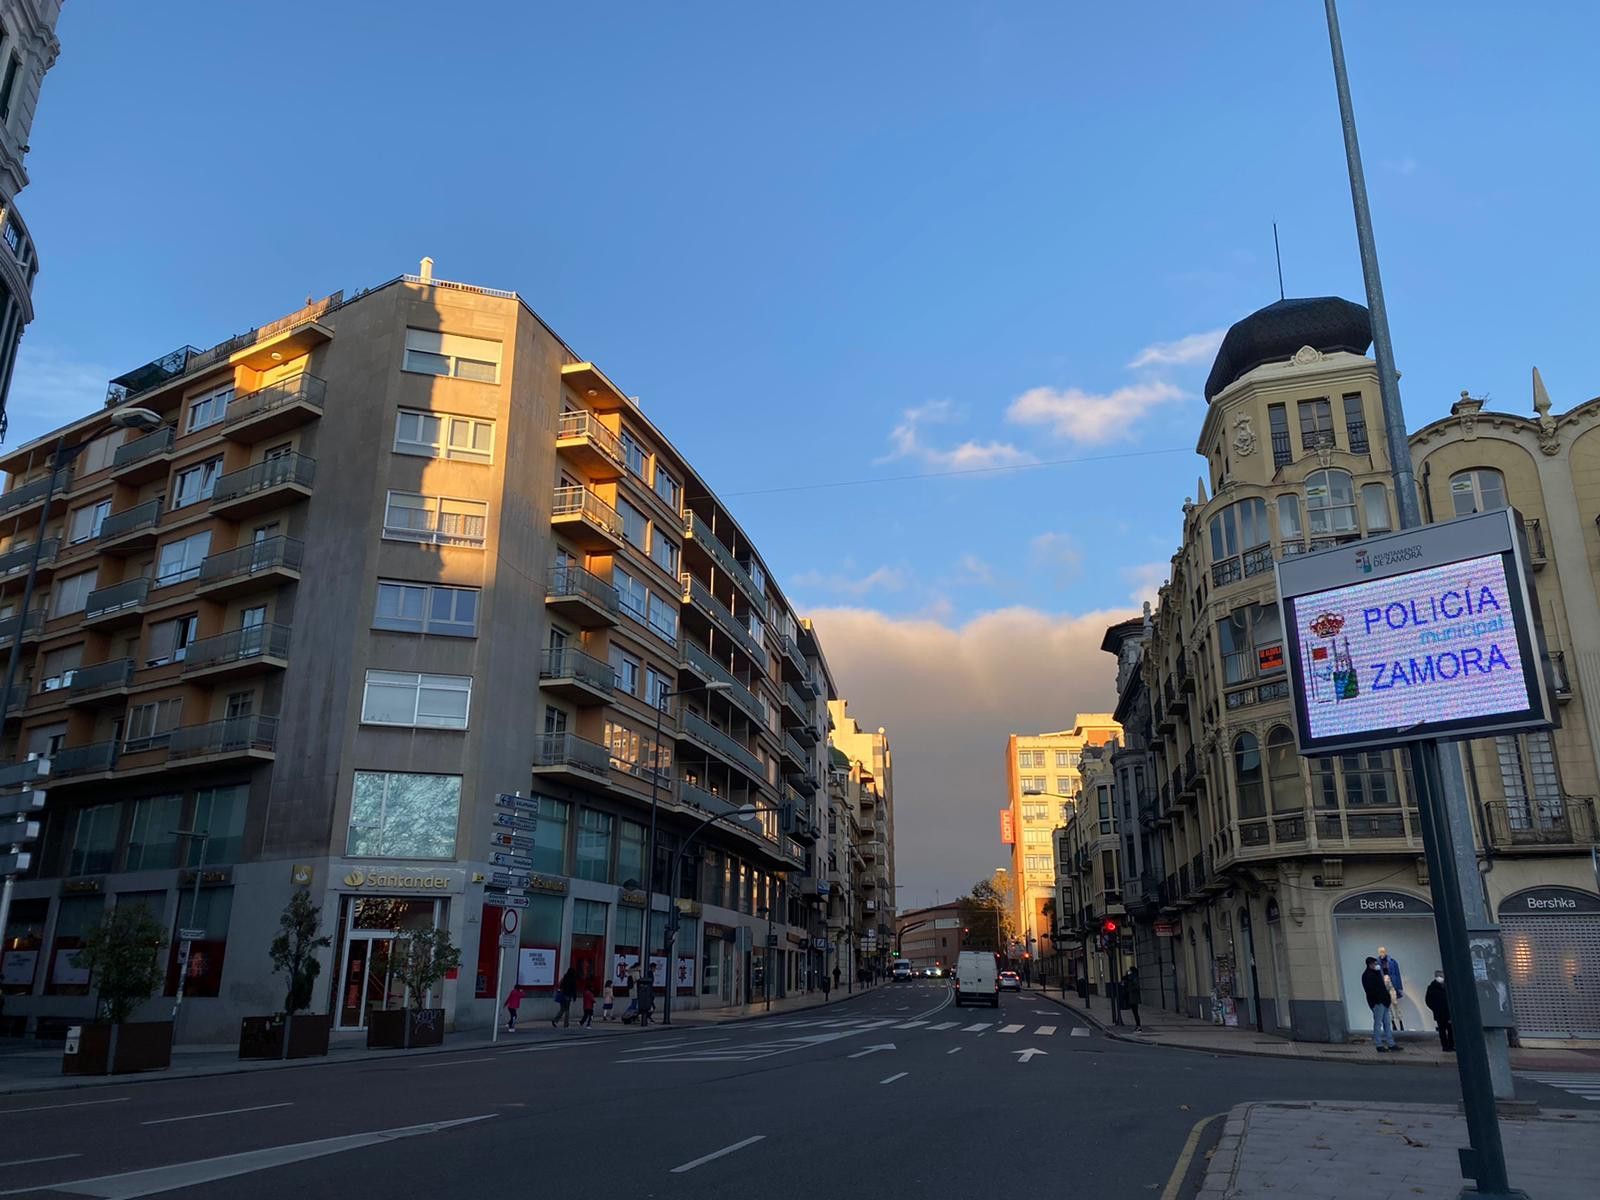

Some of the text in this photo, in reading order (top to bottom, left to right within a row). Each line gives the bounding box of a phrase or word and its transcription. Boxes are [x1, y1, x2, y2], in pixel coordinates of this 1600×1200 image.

[1373, 545, 1422, 560] AYUNTAMIENTO
[1373, 551, 1423, 568] DE ZAMORA
[1364, 581, 1501, 634] POLICÍA
[1418, 615, 1505, 647] municipal
[1371, 644, 1512, 691] ZAMORA
[366, 873, 450, 889] Santander
[1360, 899, 1405, 910] Bershka
[1527, 897, 1577, 909] Bershka
